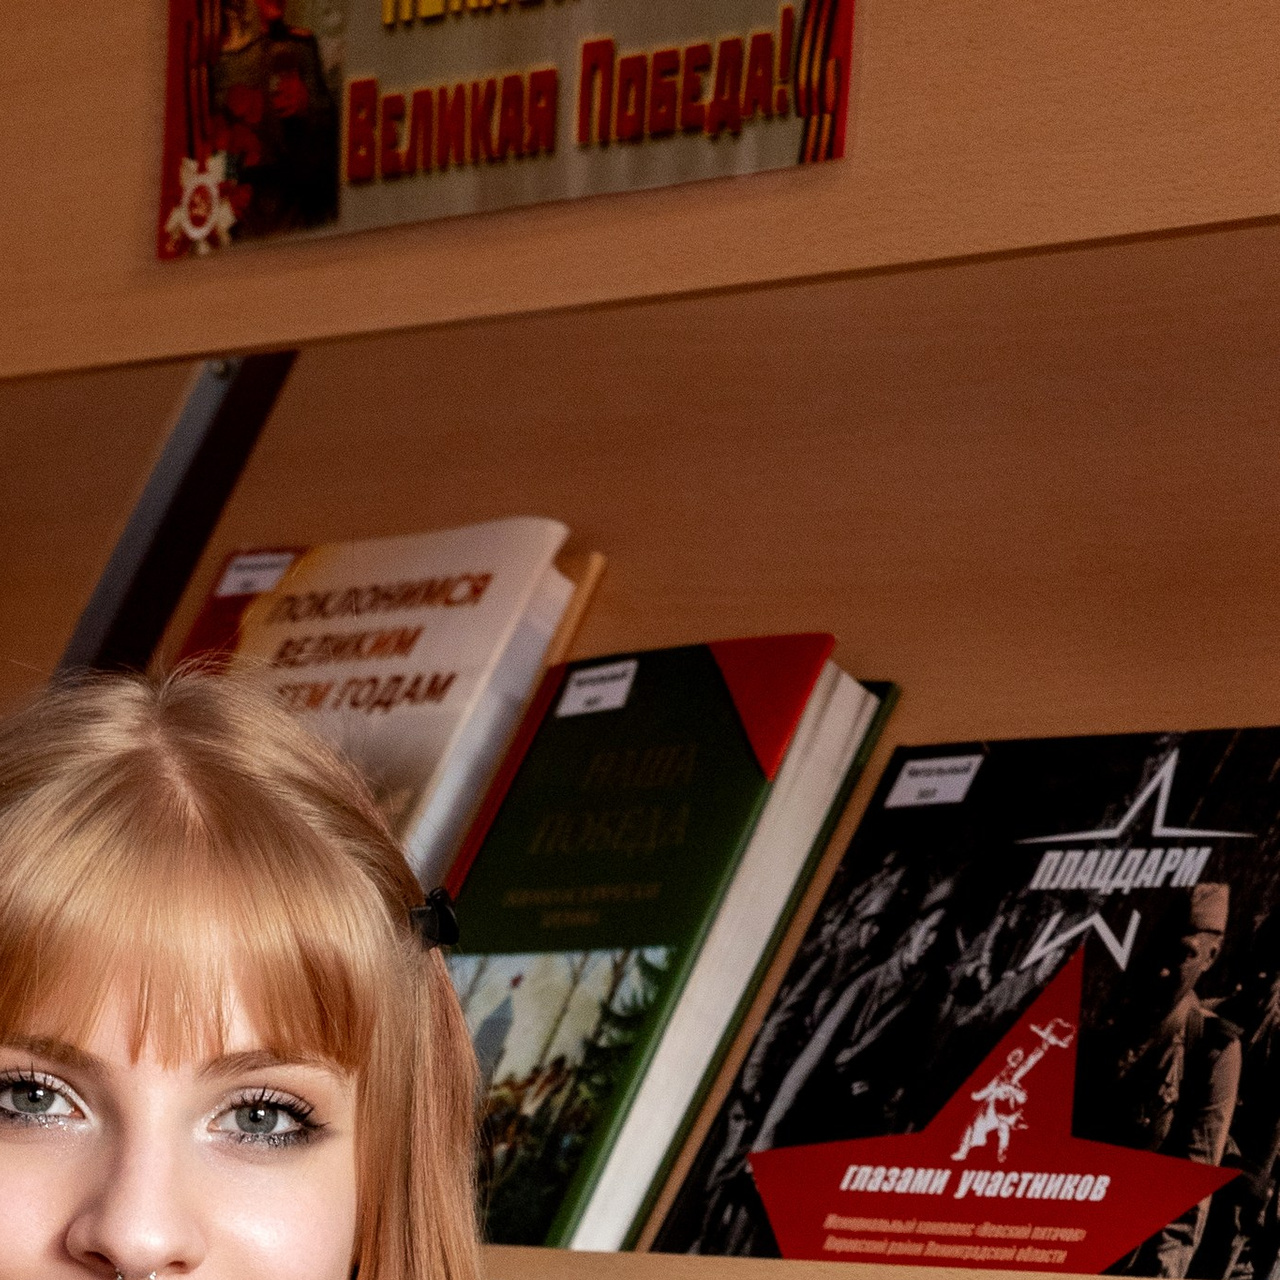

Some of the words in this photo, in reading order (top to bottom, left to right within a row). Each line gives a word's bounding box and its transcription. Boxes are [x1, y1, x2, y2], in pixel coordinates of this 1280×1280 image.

[346, 66, 558, 186] ВЕЛИКАЯ
[578, 5, 795, 148] ПОБЕДА!
[1029, 846, 1212, 896] ПЛАЦДАРМ
